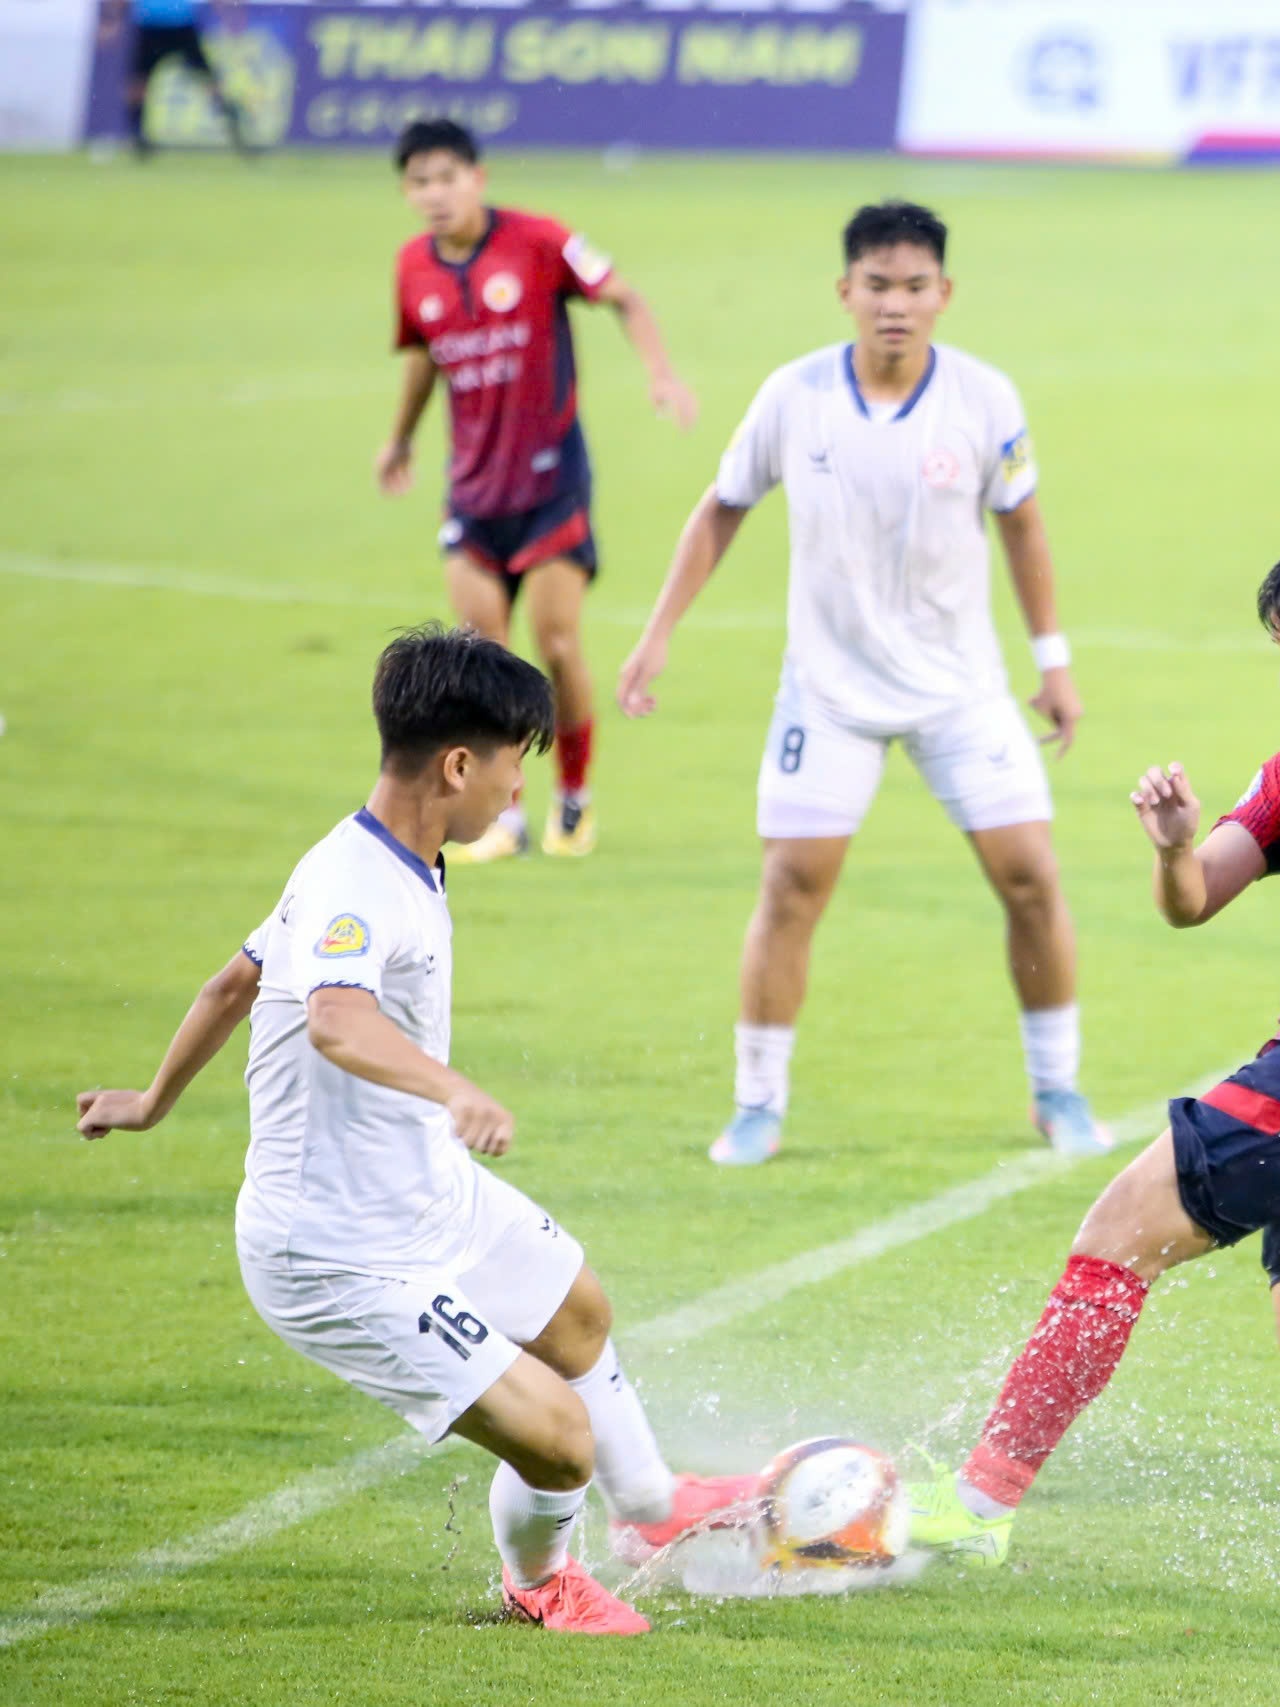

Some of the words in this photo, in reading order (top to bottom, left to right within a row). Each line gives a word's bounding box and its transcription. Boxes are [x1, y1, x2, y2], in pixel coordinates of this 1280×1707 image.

[675, 20, 864, 87] NAM
[780, 726, 805, 774] 8
[418, 1294, 489, 1362] 16
